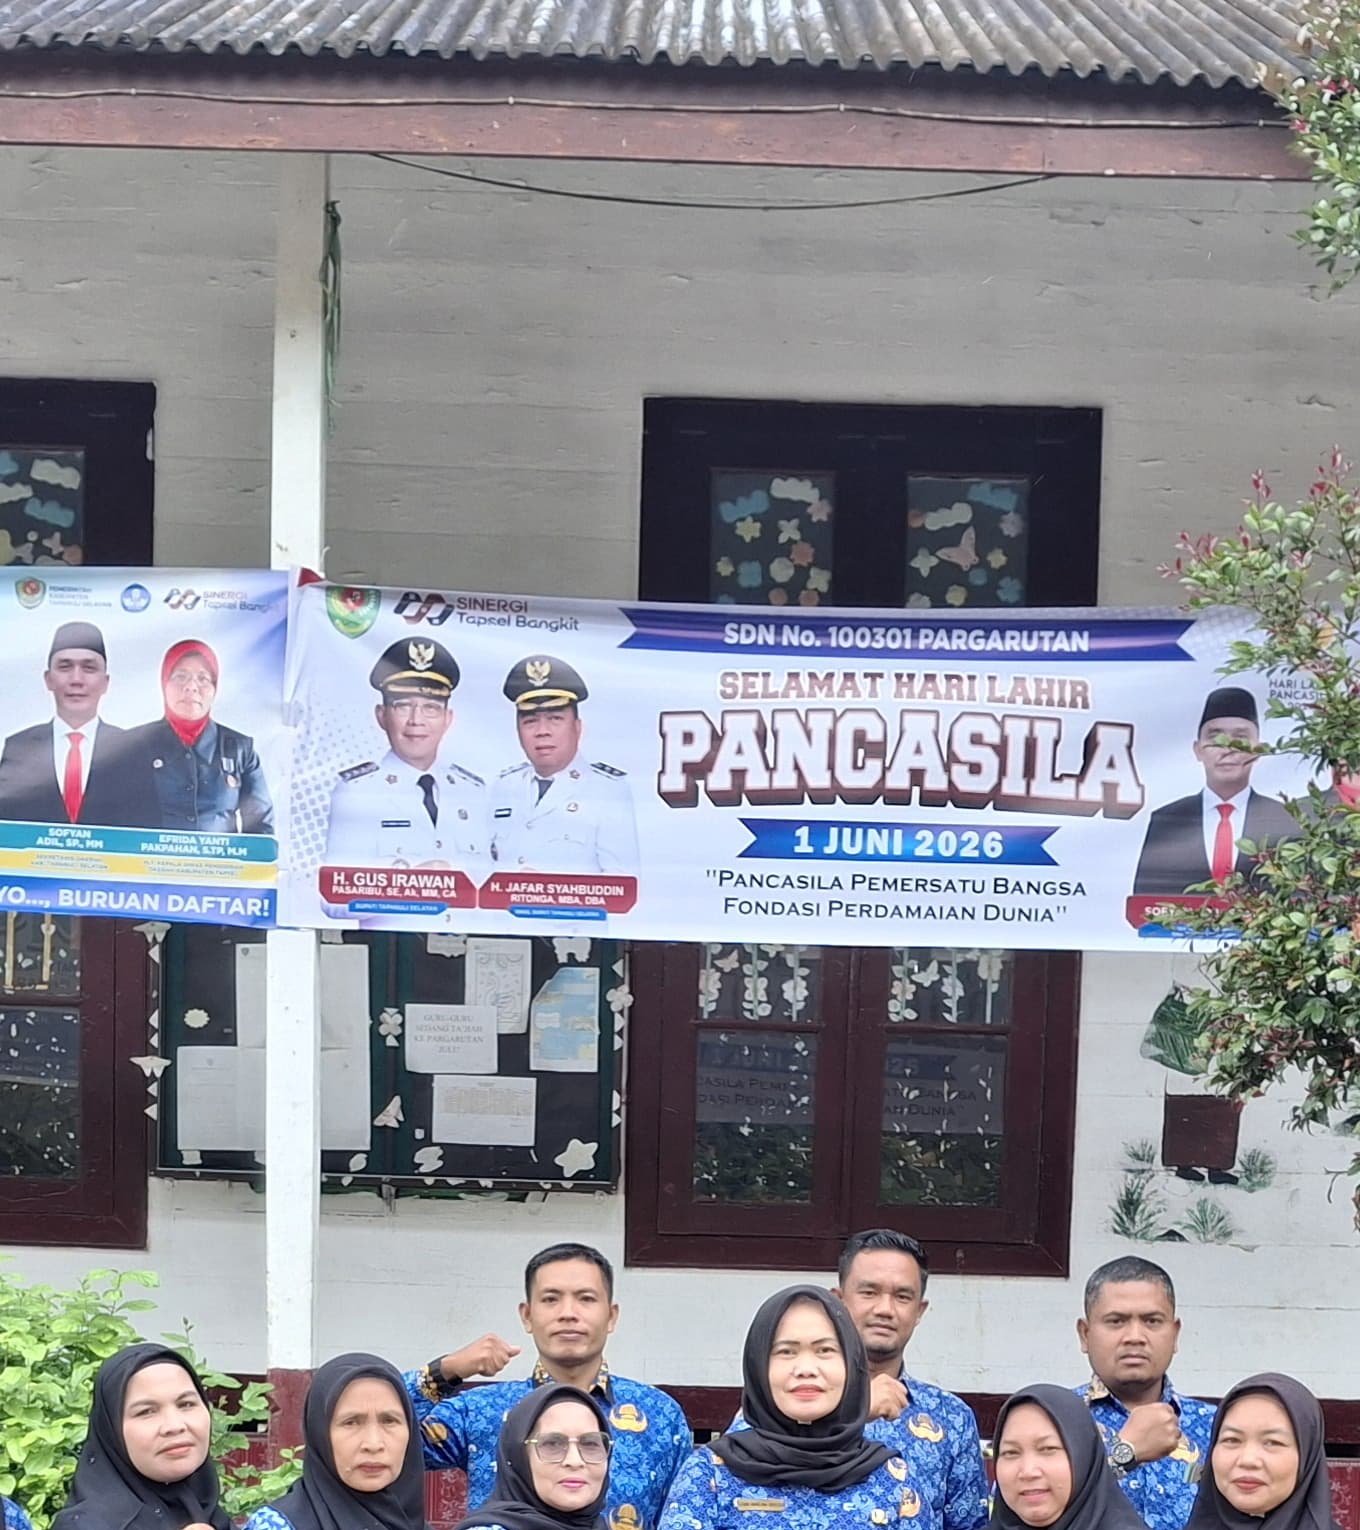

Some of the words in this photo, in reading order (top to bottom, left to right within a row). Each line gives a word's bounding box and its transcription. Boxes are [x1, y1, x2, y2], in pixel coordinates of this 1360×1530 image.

[455, 597, 528, 613] SINERGI
[456, 611, 511, 628] Tapsel
[515, 614, 579, 632] Bangkit
[724, 623, 775, 645] SDN
[781, 625, 821, 647] No.
[828, 626, 912, 649] 100301
[919, 628, 1089, 652] PARGARUTAN
[720, 671, 884, 699] SELAMAT
[894, 672, 977, 702] HARI
[987, 675, 1090, 709] LAHIR
[1269, 679, 1297, 688] HARI
[658, 708, 1145, 820] PANCASILA
[48, 828, 92, 839] SOFYAN
[159, 834, 198, 845] EFRIDA
[199, 836, 230, 846] YANTI
[794, 826, 814, 853] 1
[823, 827, 903, 855] JUNI
[914, 830, 1003, 859] 2026
[333, 871, 349, 885] H.
[353, 872, 388, 887] GUS
[392, 874, 455, 889] IRAWAN
[490, 881, 502, 892] H.
[505, 882, 544, 893] JAFAR
[547, 883, 624, 896] SYAHBUDDIN
[59, 888, 160, 911] BURUAN
[167, 894, 270, 917] DAFTAR!
